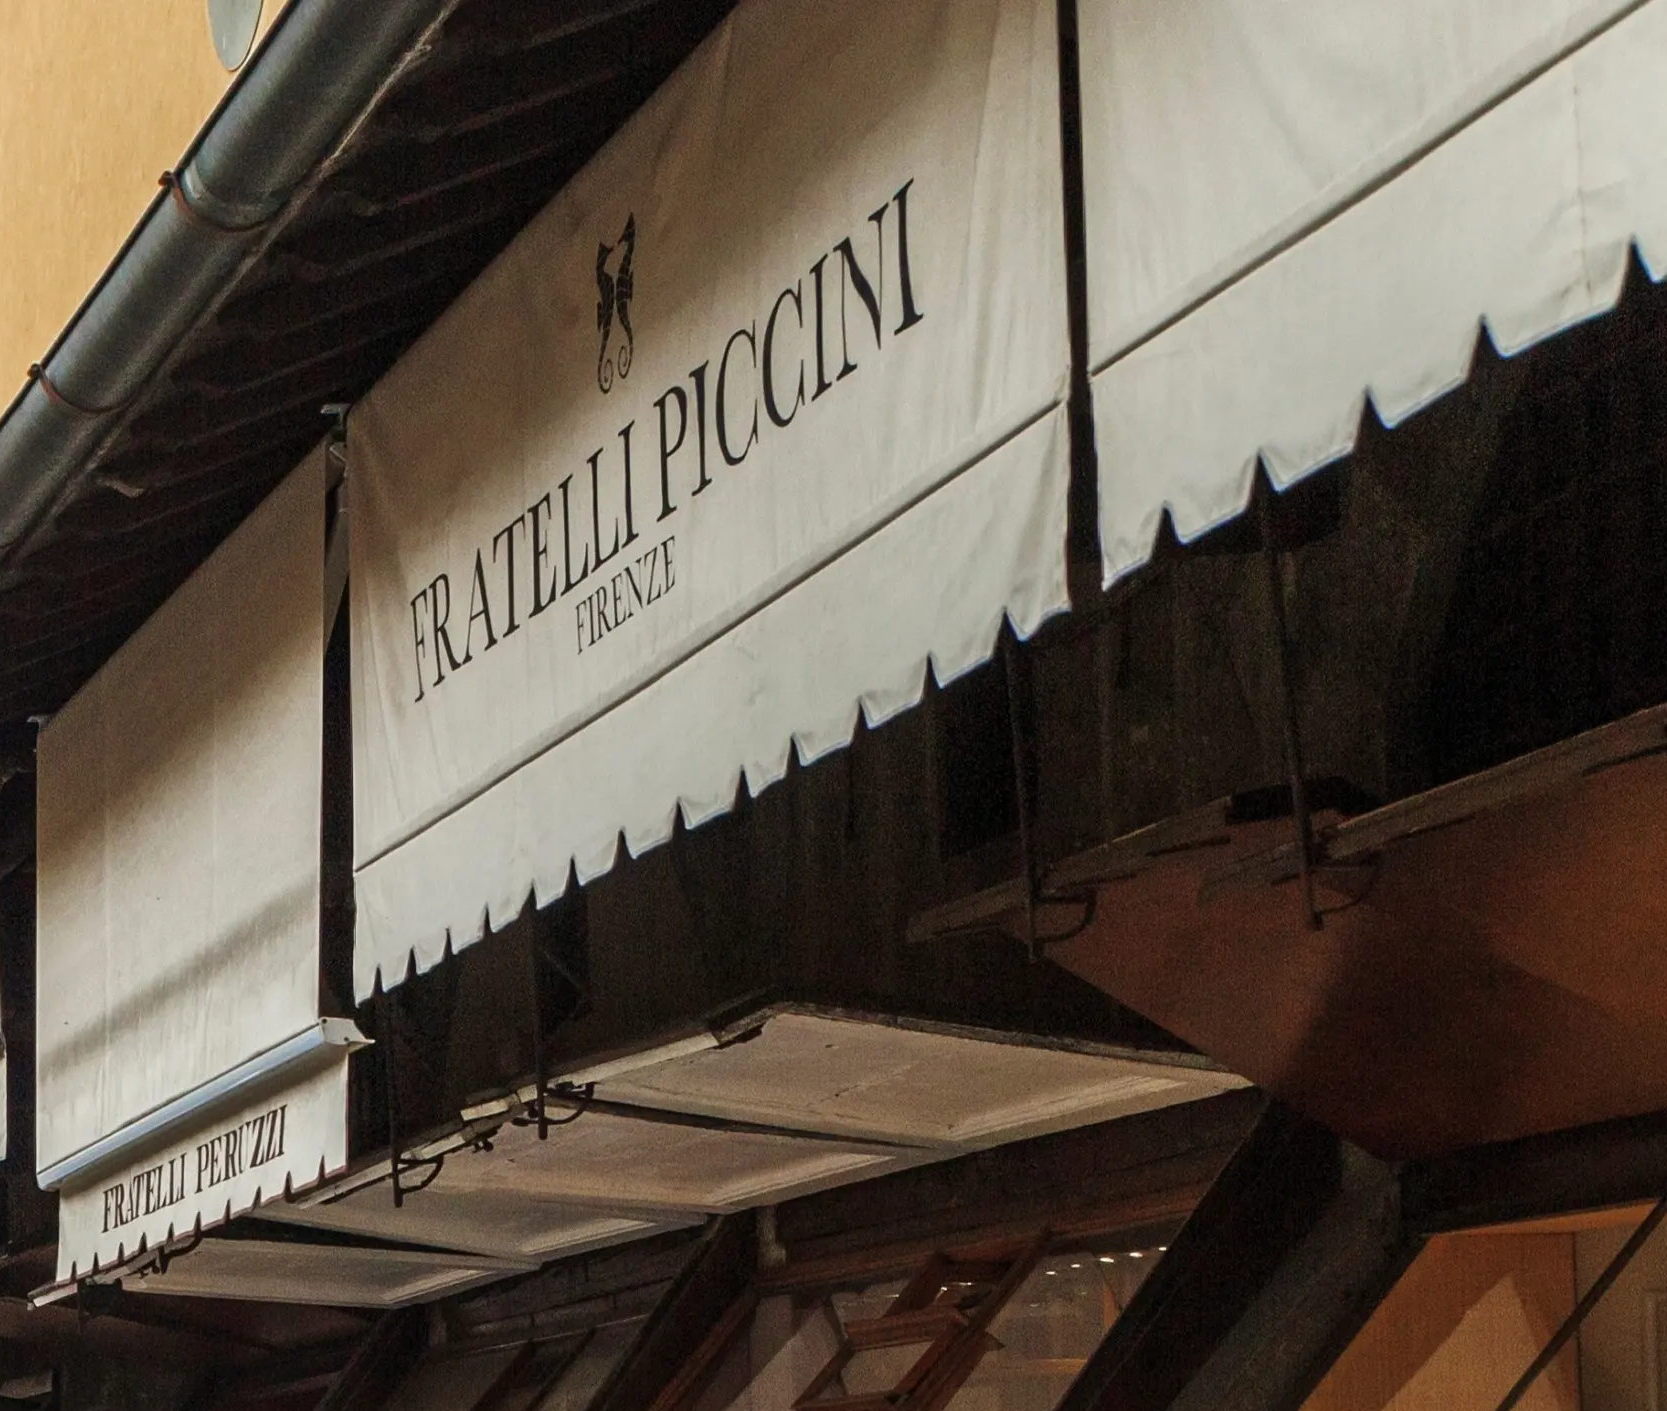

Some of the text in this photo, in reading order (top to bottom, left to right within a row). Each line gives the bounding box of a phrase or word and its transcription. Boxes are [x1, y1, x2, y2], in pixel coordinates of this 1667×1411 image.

[410, 177, 925, 703] FRATELLI PICCINI
[574, 534, 677, 655] FIRENZE
[101, 1104, 288, 1234] FRATELLI PERUZZI
